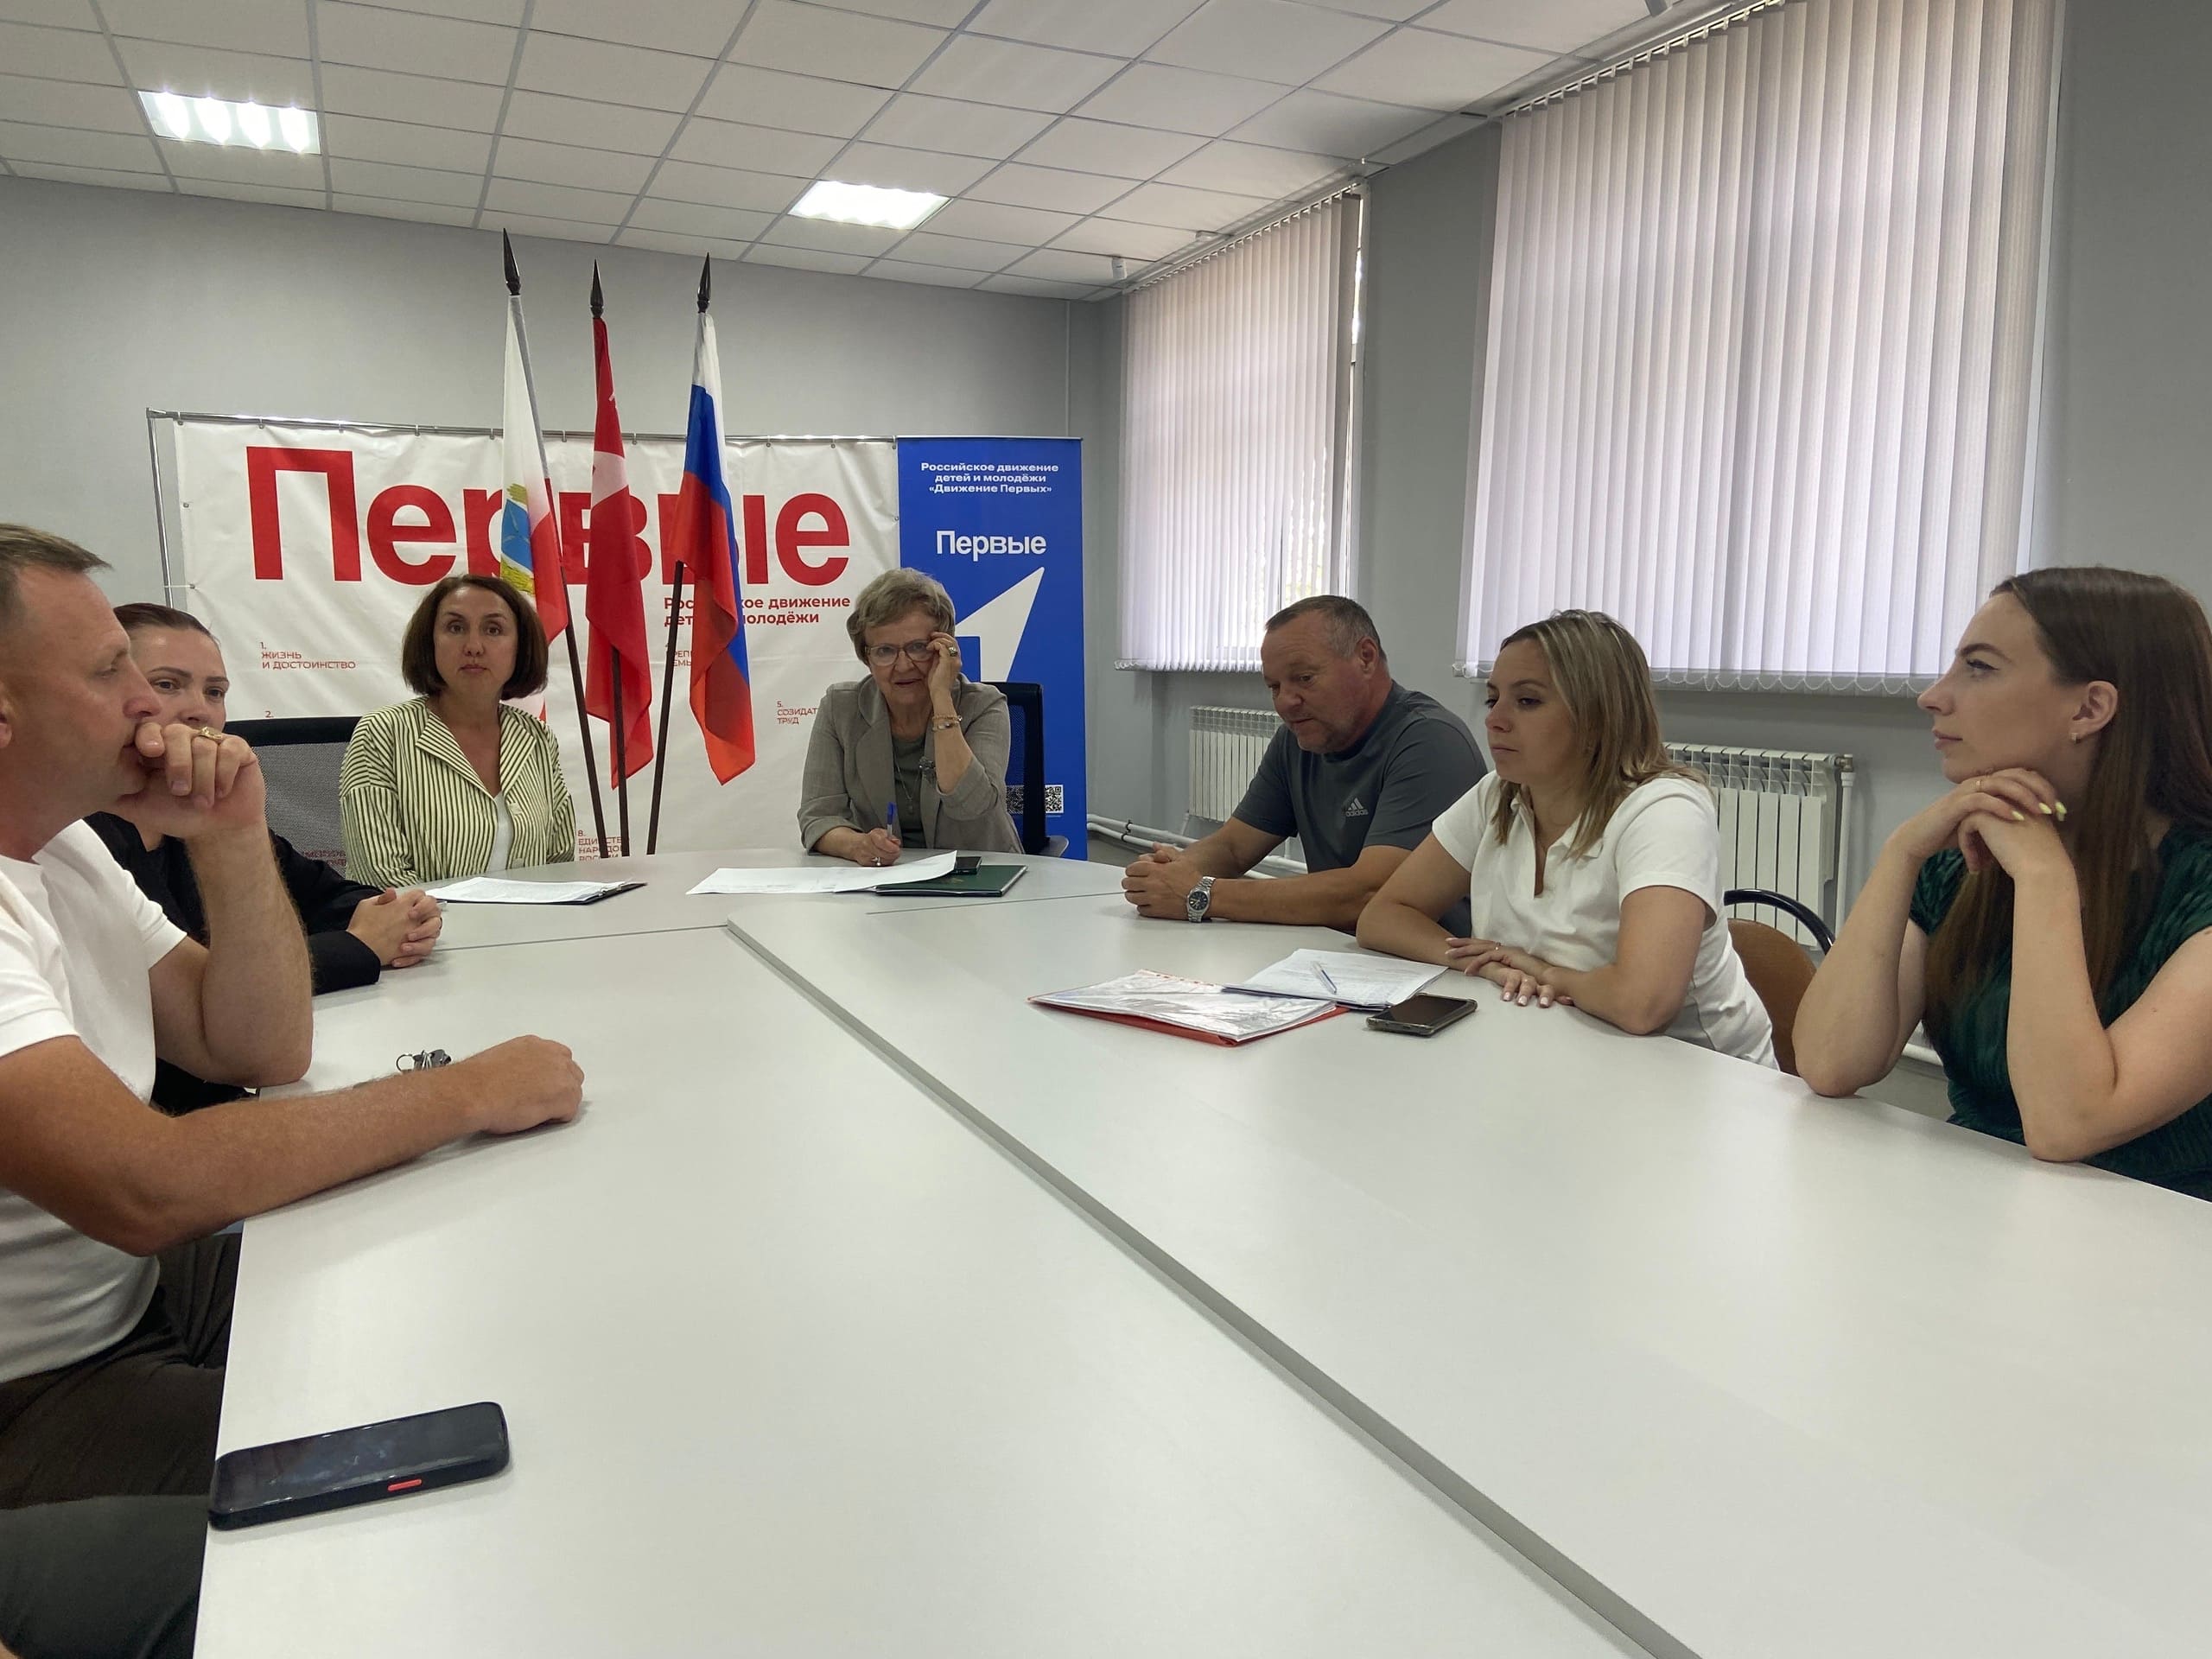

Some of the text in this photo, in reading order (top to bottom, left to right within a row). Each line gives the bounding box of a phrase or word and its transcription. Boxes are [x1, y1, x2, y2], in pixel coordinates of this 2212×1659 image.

[997, 464, 1058, 473] движение
[935, 474, 970, 483] детей
[983, 474, 1046, 483] молодёжи
[929, 485, 1052, 494] «Движение Первых»
[937, 531, 1046, 562] Первые
[768, 598, 850, 609] движение
[273, 661, 356, 671] ДОСТОИНСТВО
